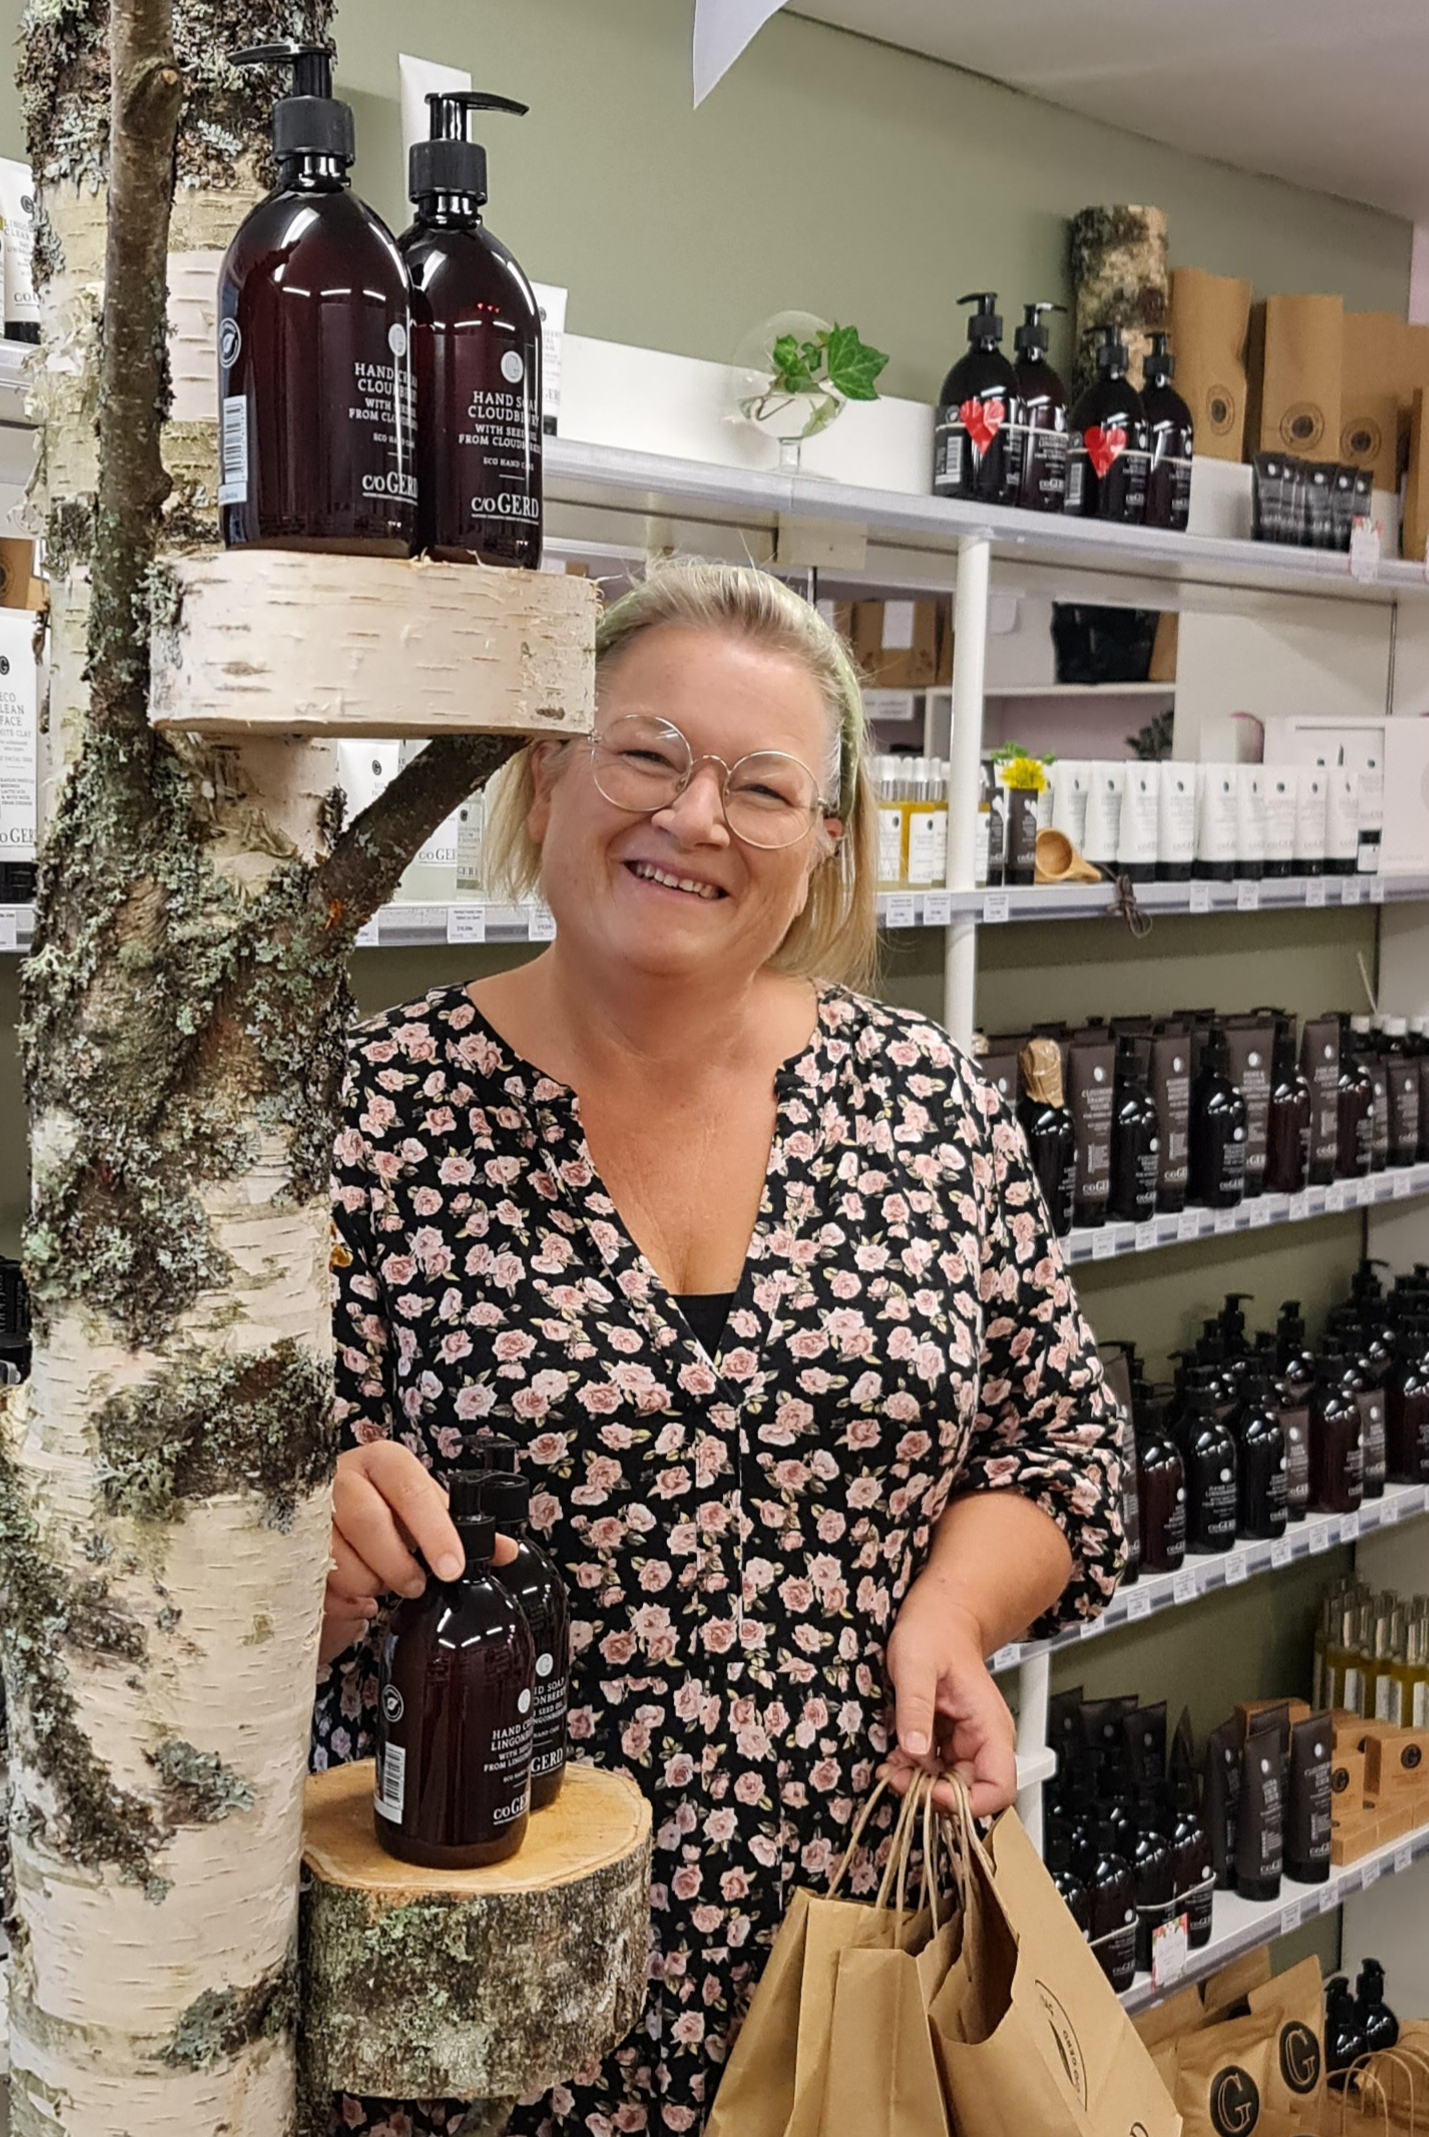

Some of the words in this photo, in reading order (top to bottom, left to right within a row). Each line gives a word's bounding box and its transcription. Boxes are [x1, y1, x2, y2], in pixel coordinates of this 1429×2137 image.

[354, 362, 394, 380] HAND
[365, 397, 391, 410] WITH
[473, 391, 514, 407] HAND
[348, 407, 379, 421] FROM
[475, 423, 504, 435] WITH
[458, 434, 489, 446] FROM
[483, 456, 498, 466] ECO
[500, 458, 520, 468] HAND
[497, 492, 539, 519] GERD
[492, 1723, 521, 1741] HAND
[483, 1760, 507, 1773] FROM
[530, 1747, 563, 1774] GERD
[1285, 2027, 1316, 2087] G
[1217, 2071, 1253, 2134] G
